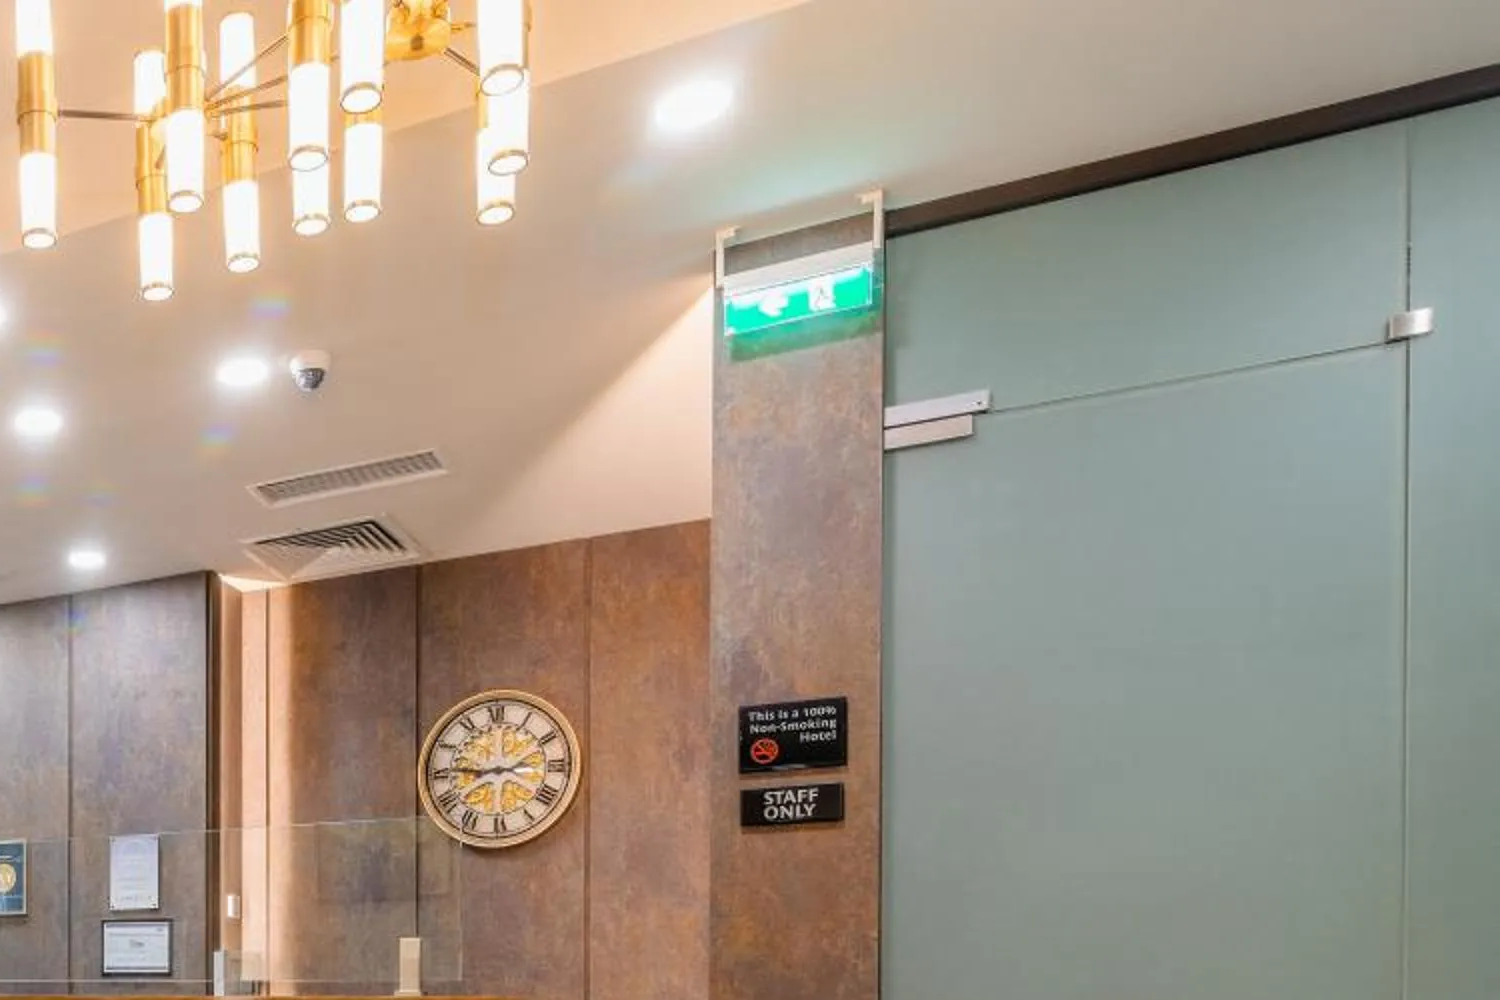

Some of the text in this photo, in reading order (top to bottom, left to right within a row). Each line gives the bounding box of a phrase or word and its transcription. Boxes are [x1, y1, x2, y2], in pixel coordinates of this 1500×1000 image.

[748, 705, 837, 721] This is a 100%
[749, 718, 837, 734] Non-Smoking
[800, 729, 837, 742] Hotel
[763, 787, 819, 805] STAFF
[763, 803, 817, 820] ONLY
